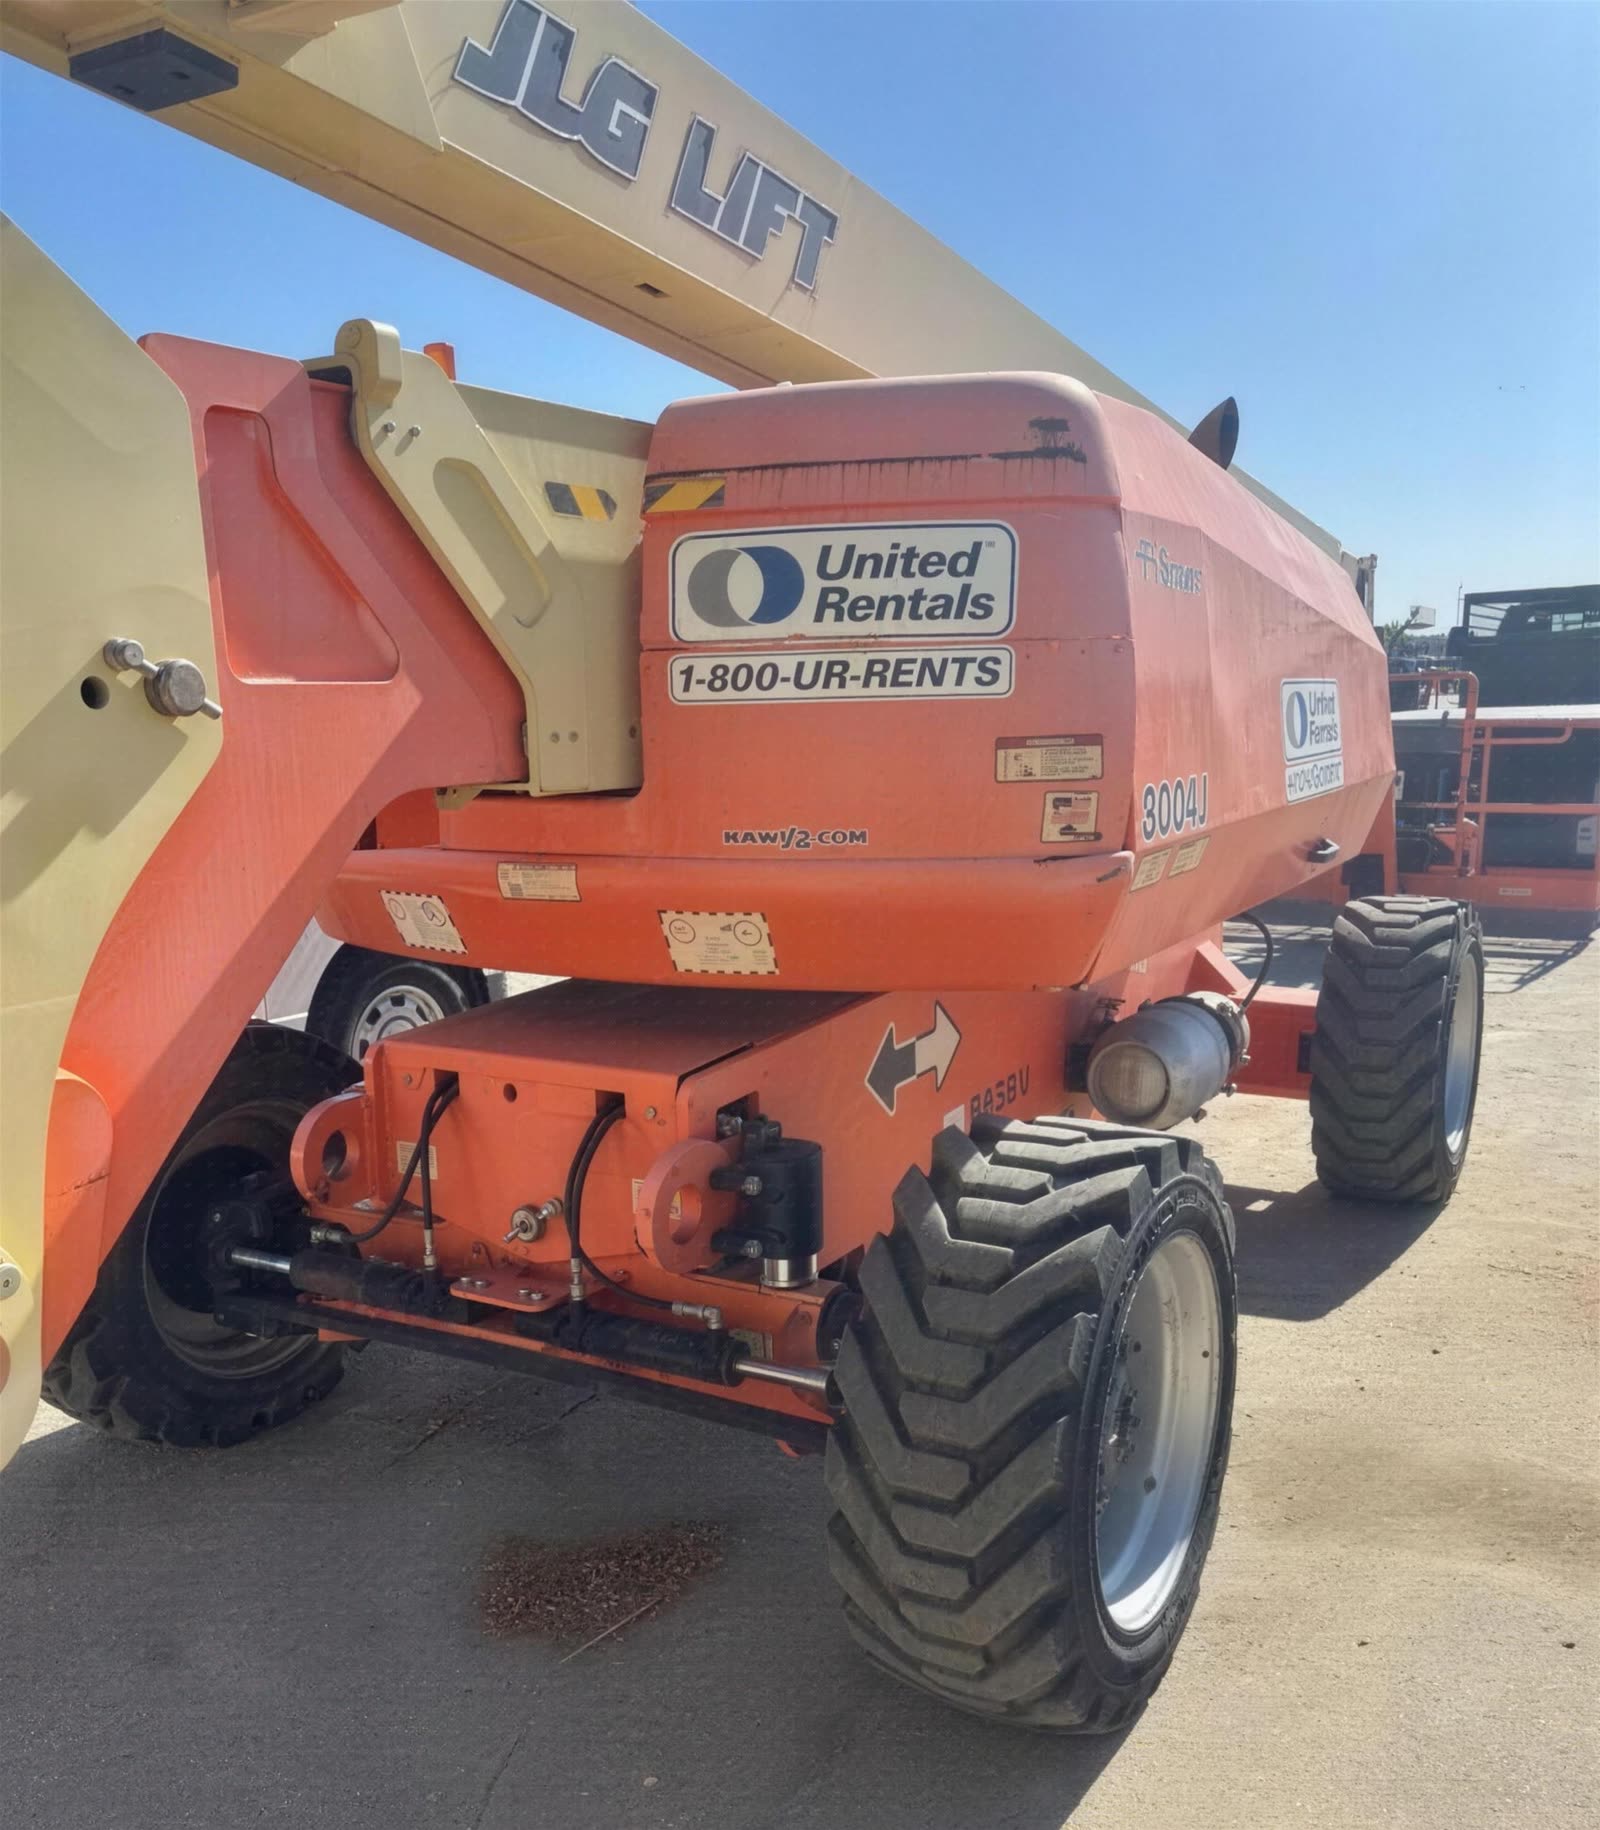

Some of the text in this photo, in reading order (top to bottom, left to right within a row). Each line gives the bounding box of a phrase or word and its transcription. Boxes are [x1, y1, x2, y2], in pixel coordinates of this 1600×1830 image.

[454, 0, 840, 290] JLG LIFT
[815, 540, 983, 581] United
[812, 583, 996, 623] Rentals
[678, 655, 1002, 693] 1-800-UR-RENTS
[1142, 773, 1208, 841] 3004J
